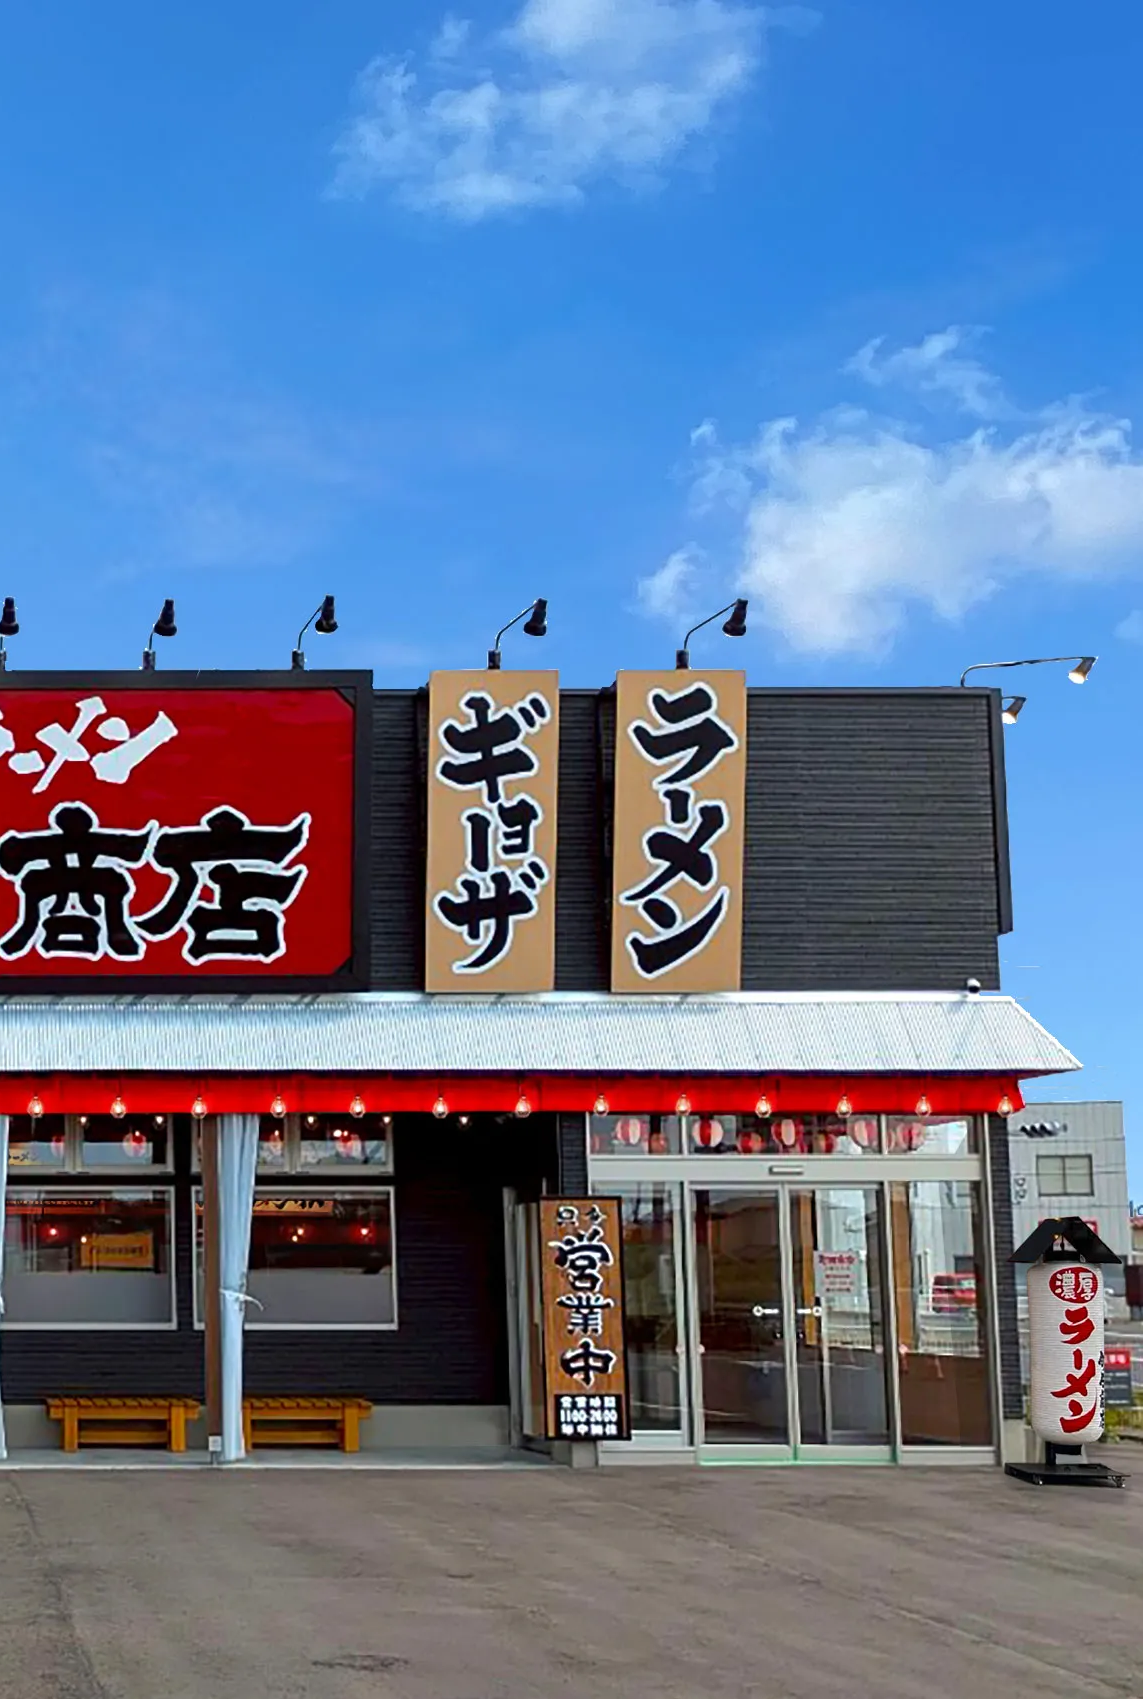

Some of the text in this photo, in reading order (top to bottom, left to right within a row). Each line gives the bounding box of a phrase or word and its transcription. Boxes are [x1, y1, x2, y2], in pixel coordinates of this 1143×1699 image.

[436, 691, 551, 974] ギョーザ
[619, 681, 739, 980] ラーメン
[548, 1225, 617, 1390] 営業中
[1055, 1270, 1095, 1300] 濃厚
[1051, 1305, 1097, 1433] ラーメン
